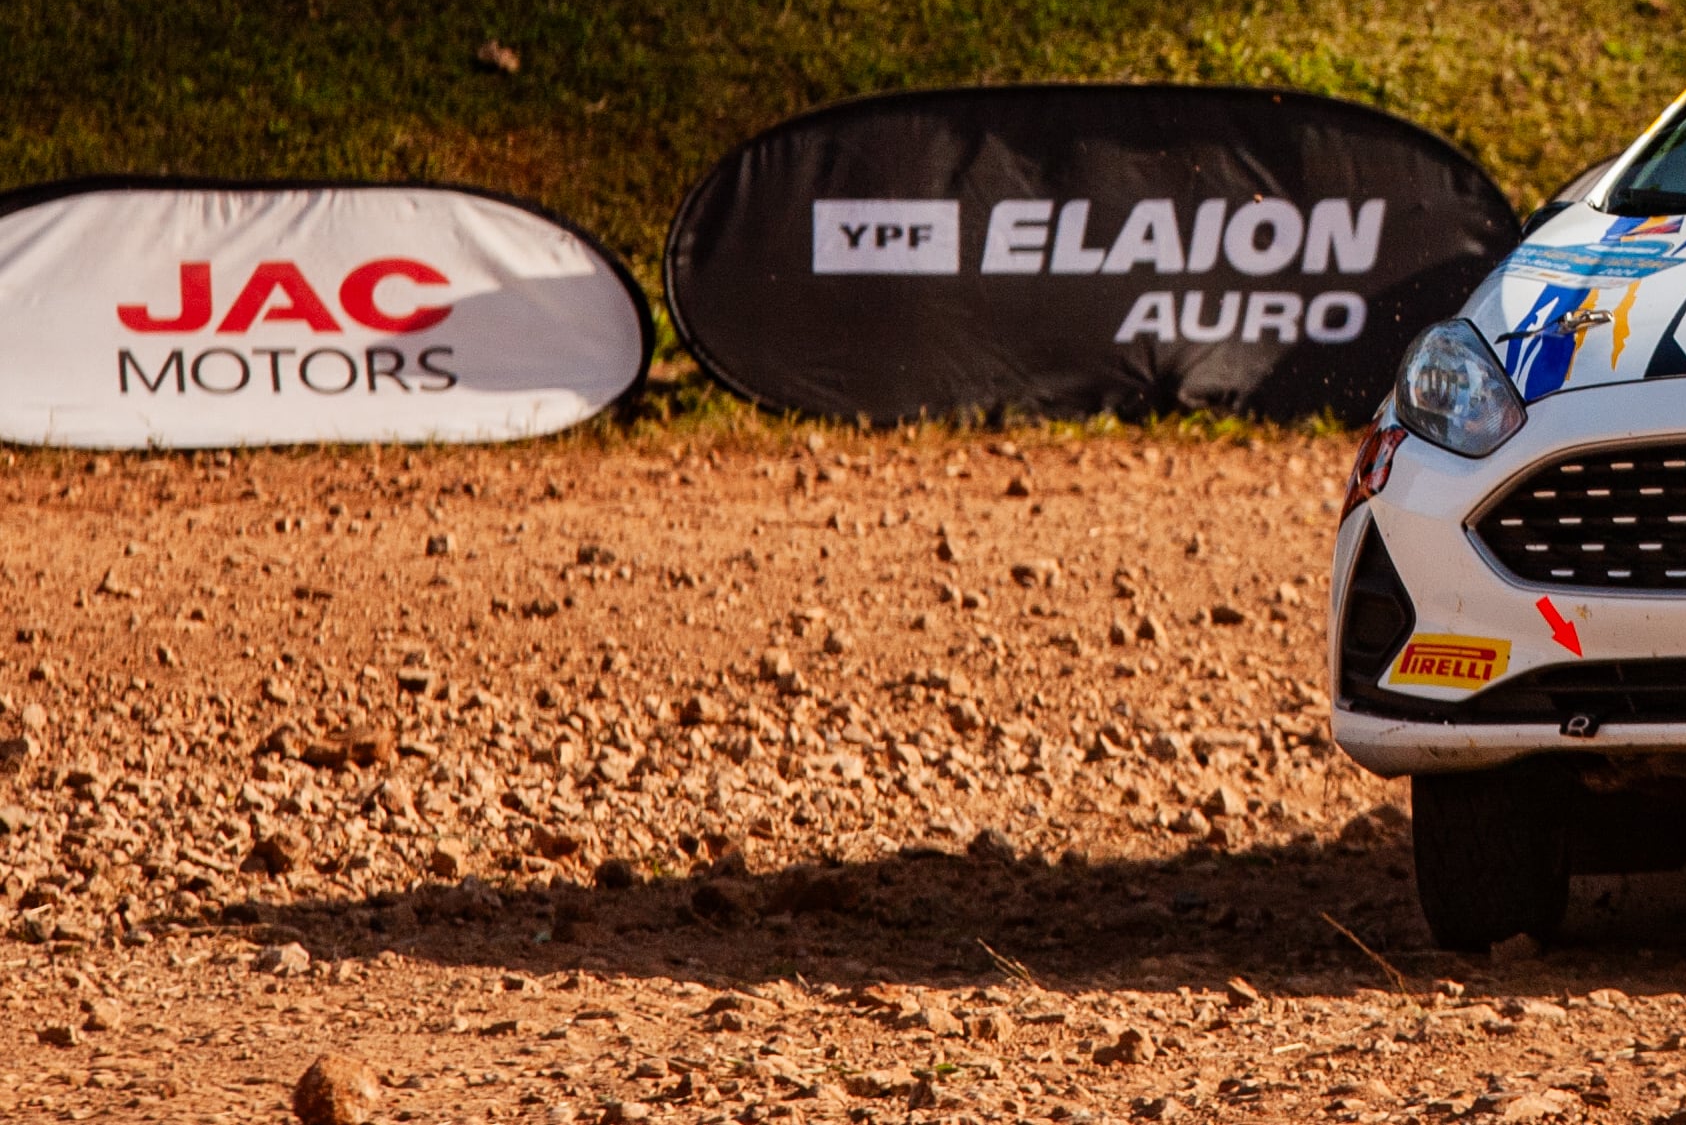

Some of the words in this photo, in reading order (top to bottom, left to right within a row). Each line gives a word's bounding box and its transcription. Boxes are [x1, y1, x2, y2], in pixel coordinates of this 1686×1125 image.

[839, 222, 933, 251] YPF
[980, 197, 1387, 275] ELAION
[117, 257, 454, 334] JAC
[1113, 290, 1368, 344] AURO
[117, 345, 458, 395] MOTORS
[1398, 643, 1497, 682] PIRELLI
